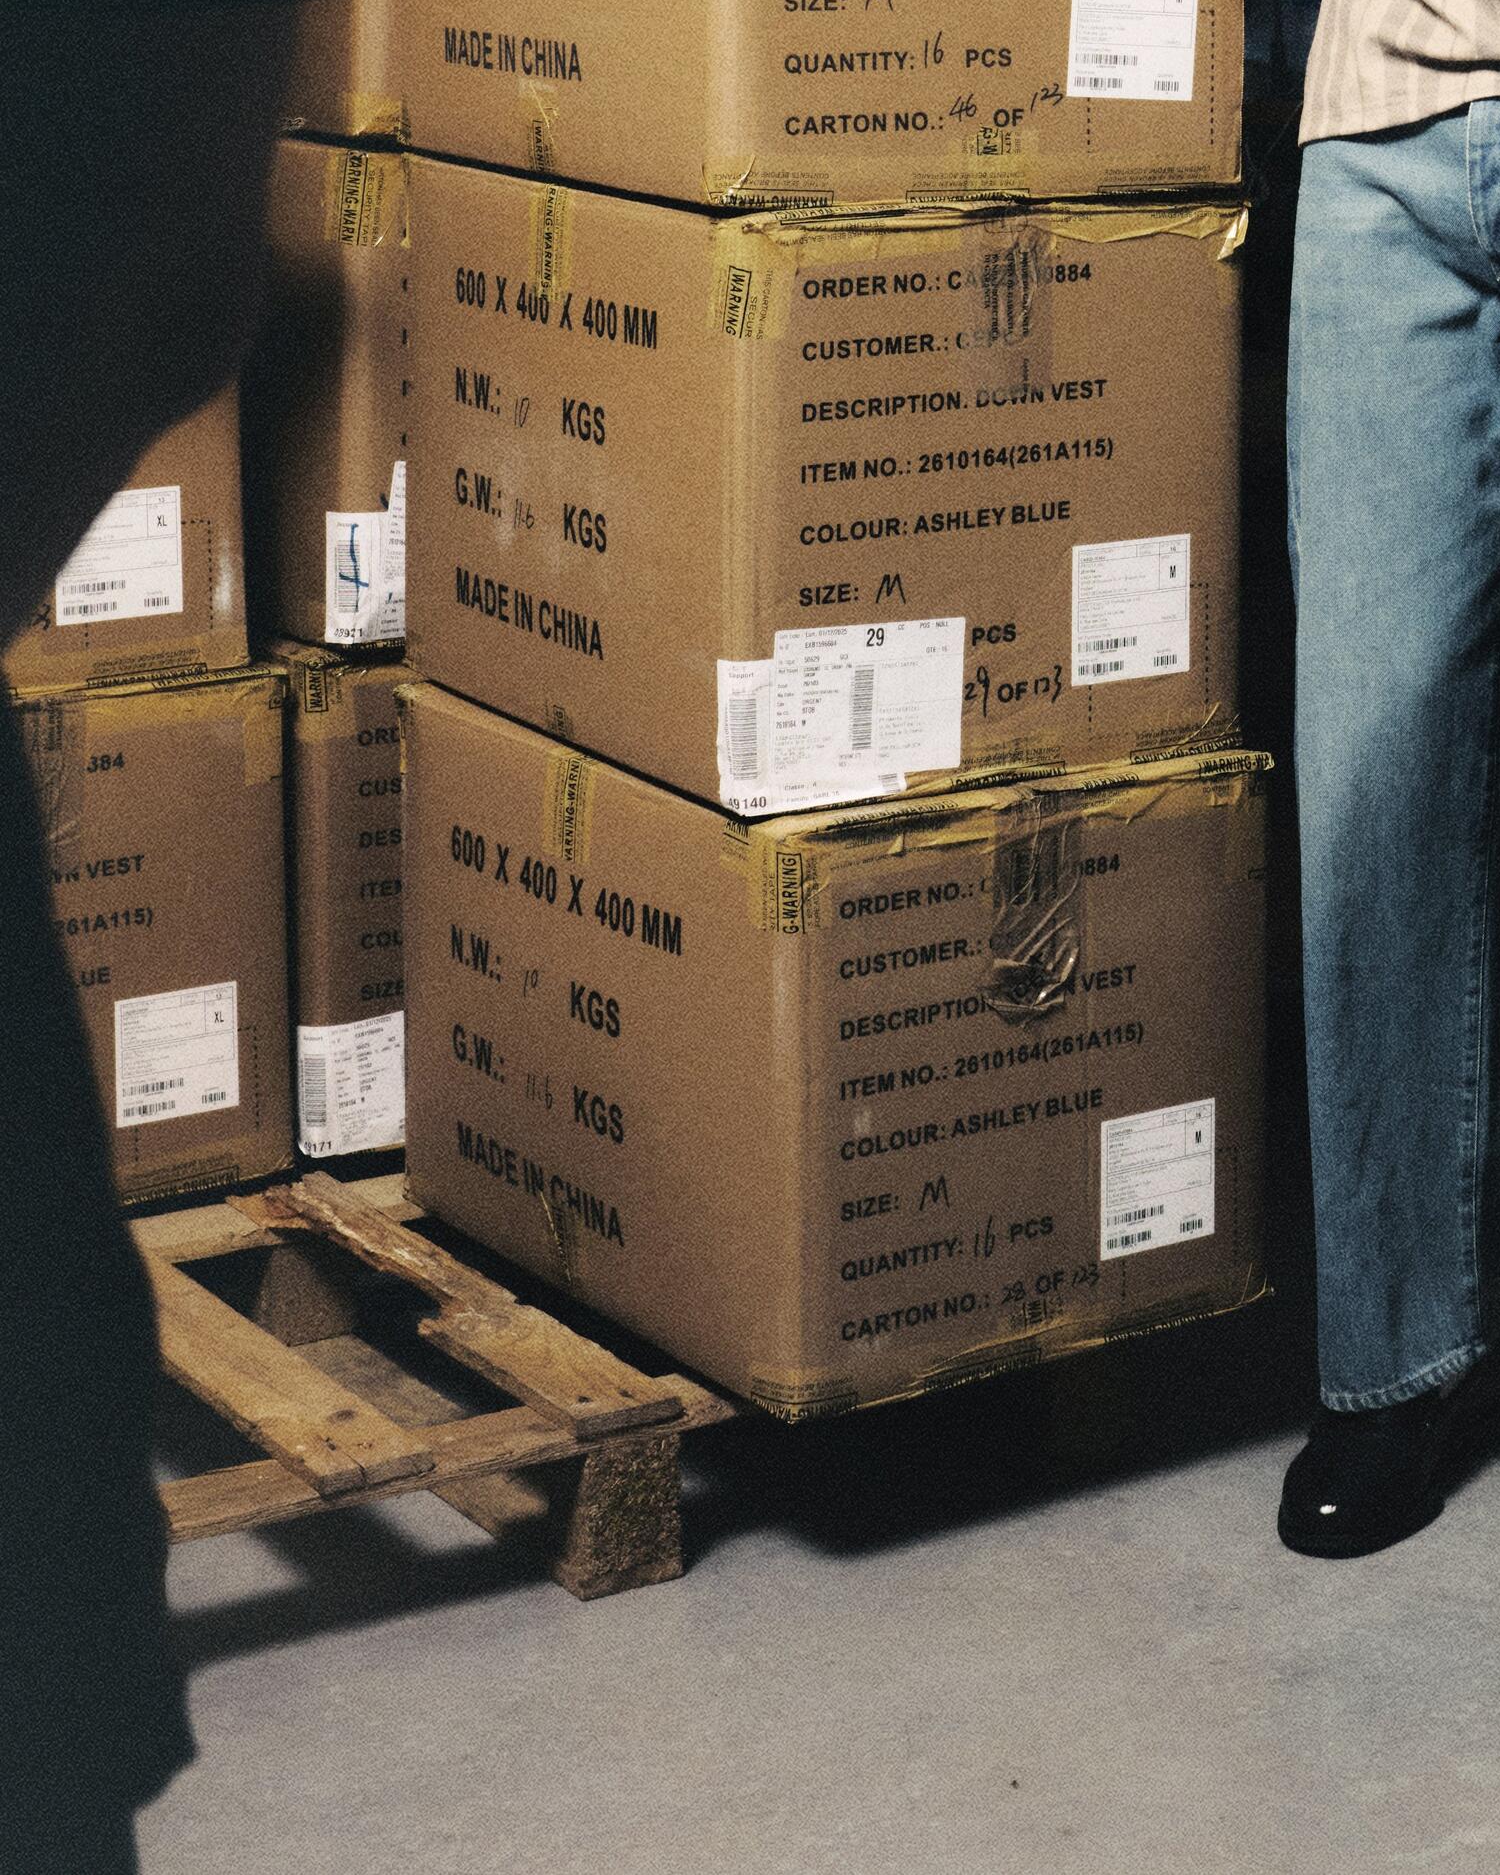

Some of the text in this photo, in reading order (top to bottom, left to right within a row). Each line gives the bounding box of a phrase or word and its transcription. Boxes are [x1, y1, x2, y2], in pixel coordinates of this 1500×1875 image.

[444, 26, 582, 82] MADE IN CHINA
[784, 31, 1013, 74] QUANTITY: 16 PCS
[784, 112, 888, 136] CARTON
[894, 111, 944, 131] NO.:
[993, 108, 1025, 128] OF
[725, 273, 746, 336] WARNING
[803, 274, 887, 299] ORDER
[893, 272, 941, 293] NO.:
[456, 267, 657, 349] 600 X 400 X 400 MM
[802, 333, 949, 362] CUSTOMER.:
[455, 366, 500, 415] N.W.:
[562, 397, 606, 445] KGS
[1051, 379, 1108, 401] VEST
[801, 437, 1114, 485] ITEM NO.: 2610164(261A115)
[156, 515, 167, 527] XL
[455, 467, 502, 518] G.W.:
[563, 503, 607, 553] KGS
[800, 500, 1071, 546] COLOUR: ASHLEY BLUE
[799, 574, 906, 607] SIZE: M
[1169, 565, 1177, 579] M
[456, 566, 604, 660] MADE IN CHINA
[866, 627, 885, 647] 29
[972, 624, 1017, 646] PCS
[997, 681, 1029, 703] OF
[728, 795, 767, 810] 49140
[87, 855, 145, 880] VEST
[452, 825, 682, 957] 600 X 400 X 400 MM
[839, 889, 921, 920] ORDER
[927, 881, 974, 905] NO.:
[839, 938, 983, 980] CUSTOMER.:
[1081, 965, 1137, 992] VEST
[451, 924, 501, 982] N.W.:
[570, 981, 620, 1038] KGS
[213, 1011, 225, 1024] XL
[839, 1021, 1145, 1100] ITEM NO.: 2610164(261A115)
[452, 1023, 505, 1084] G.W.:
[573, 1084, 624, 1145] KGS
[839, 1089, 1104, 1161] COLOUR: ASHLEY BLUE
[1195, 1130, 1202, 1144] M
[456, 1121, 625, 1248] MADE IN CHINA
[840, 1175, 950, 1222] SIZE: M
[840, 1237, 963, 1282] QUANTITY:
[1008, 1216, 1054, 1243] PCS
[840, 1302, 938, 1341] CARTON
[943, 1292, 990, 1319] NO.:
[1034, 1271, 1066, 1295] OF
